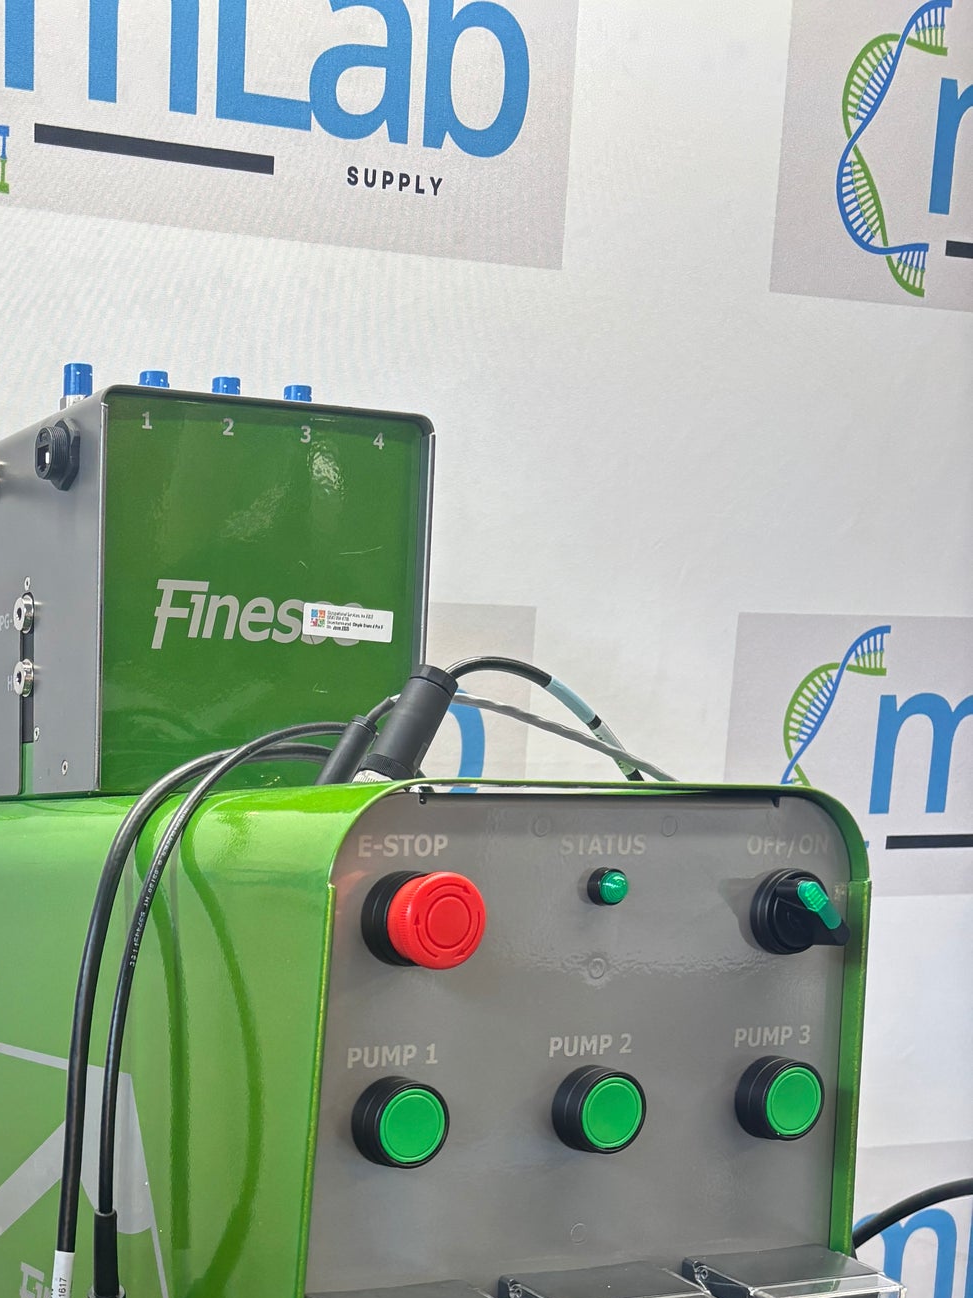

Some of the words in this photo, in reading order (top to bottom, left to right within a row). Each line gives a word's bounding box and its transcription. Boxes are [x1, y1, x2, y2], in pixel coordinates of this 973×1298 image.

[346, 165, 443, 196] SUPPLY
[141, 411, 153, 430] 1
[222, 418, 234, 436] 2
[300, 425, 311, 443] 3
[373, 432, 384, 449] 4
[358, 835, 448, 857] E-STOP
[559, 835, 647, 856] STATUS
[548, 1035, 612, 1058] PUMP
[619, 1034, 633, 1054] 2
[734, 1026, 793, 1048] PUMP
[798, 1024, 811, 1045] 3
[346, 1045, 416, 1069] PUMP
[425, 1044, 438, 1064] 1
[59, 1277, 67, 1298] 1617
